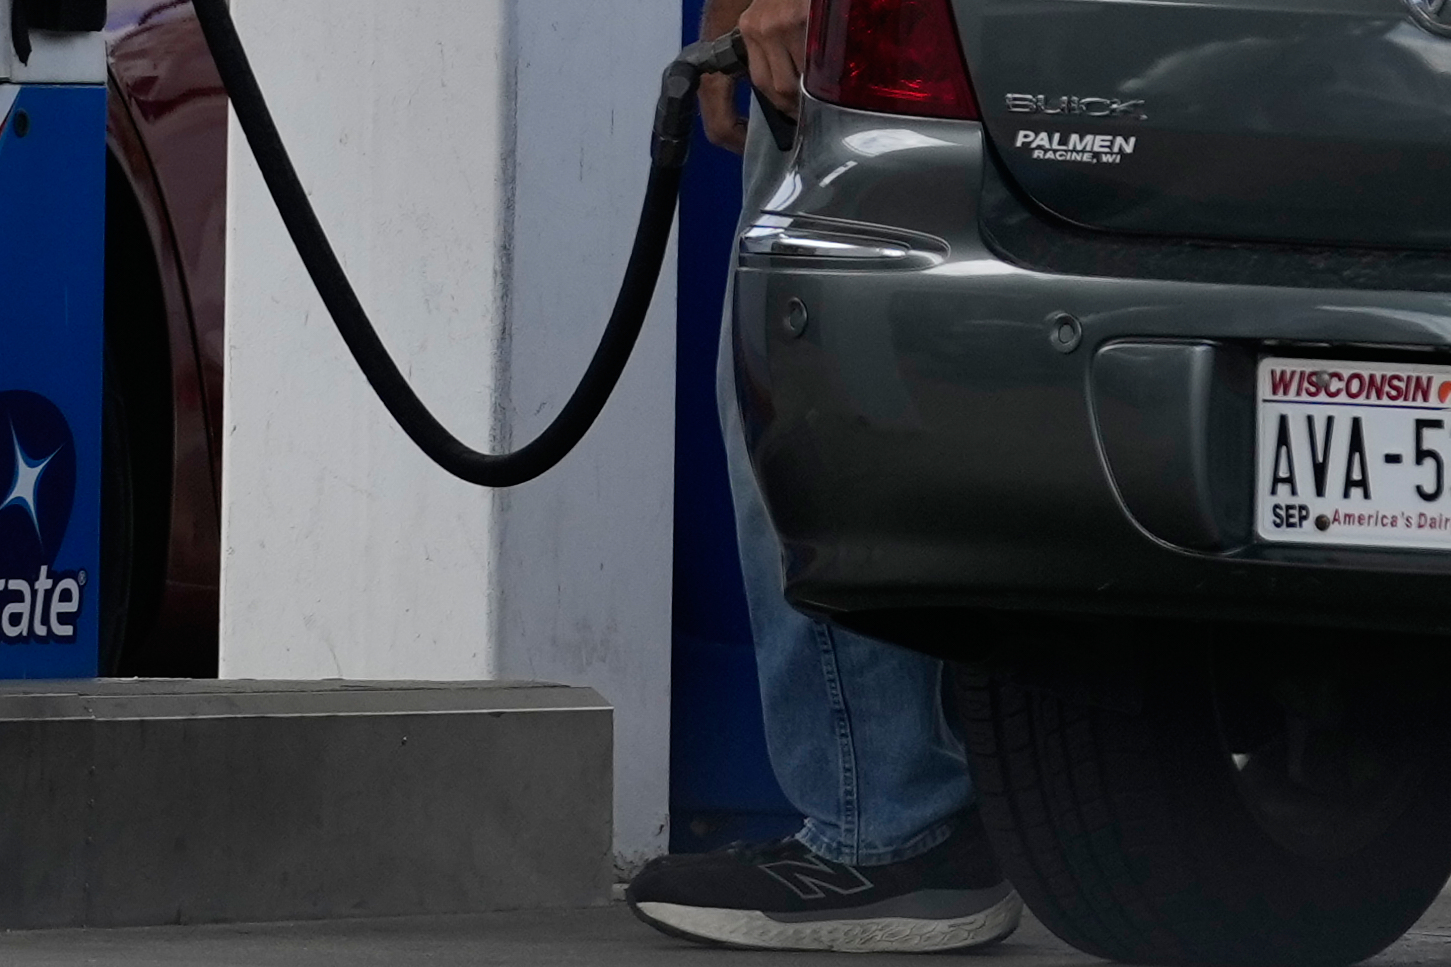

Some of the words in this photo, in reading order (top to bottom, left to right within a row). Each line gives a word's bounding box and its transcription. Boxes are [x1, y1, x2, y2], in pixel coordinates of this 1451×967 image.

[1006, 93, 1147, 120] BUICK
[1015, 130, 1136, 154] PALMEN
[1032, 149, 1097, 163] RACINE,
[1101, 154, 1121, 164] WI
[1270, 368, 1434, 403] WISCONSIN
[1270, 413, 1451, 502] AVA-5
[1272, 503, 1311, 529] SEP
[1331, 508, 1413, 529] America's
